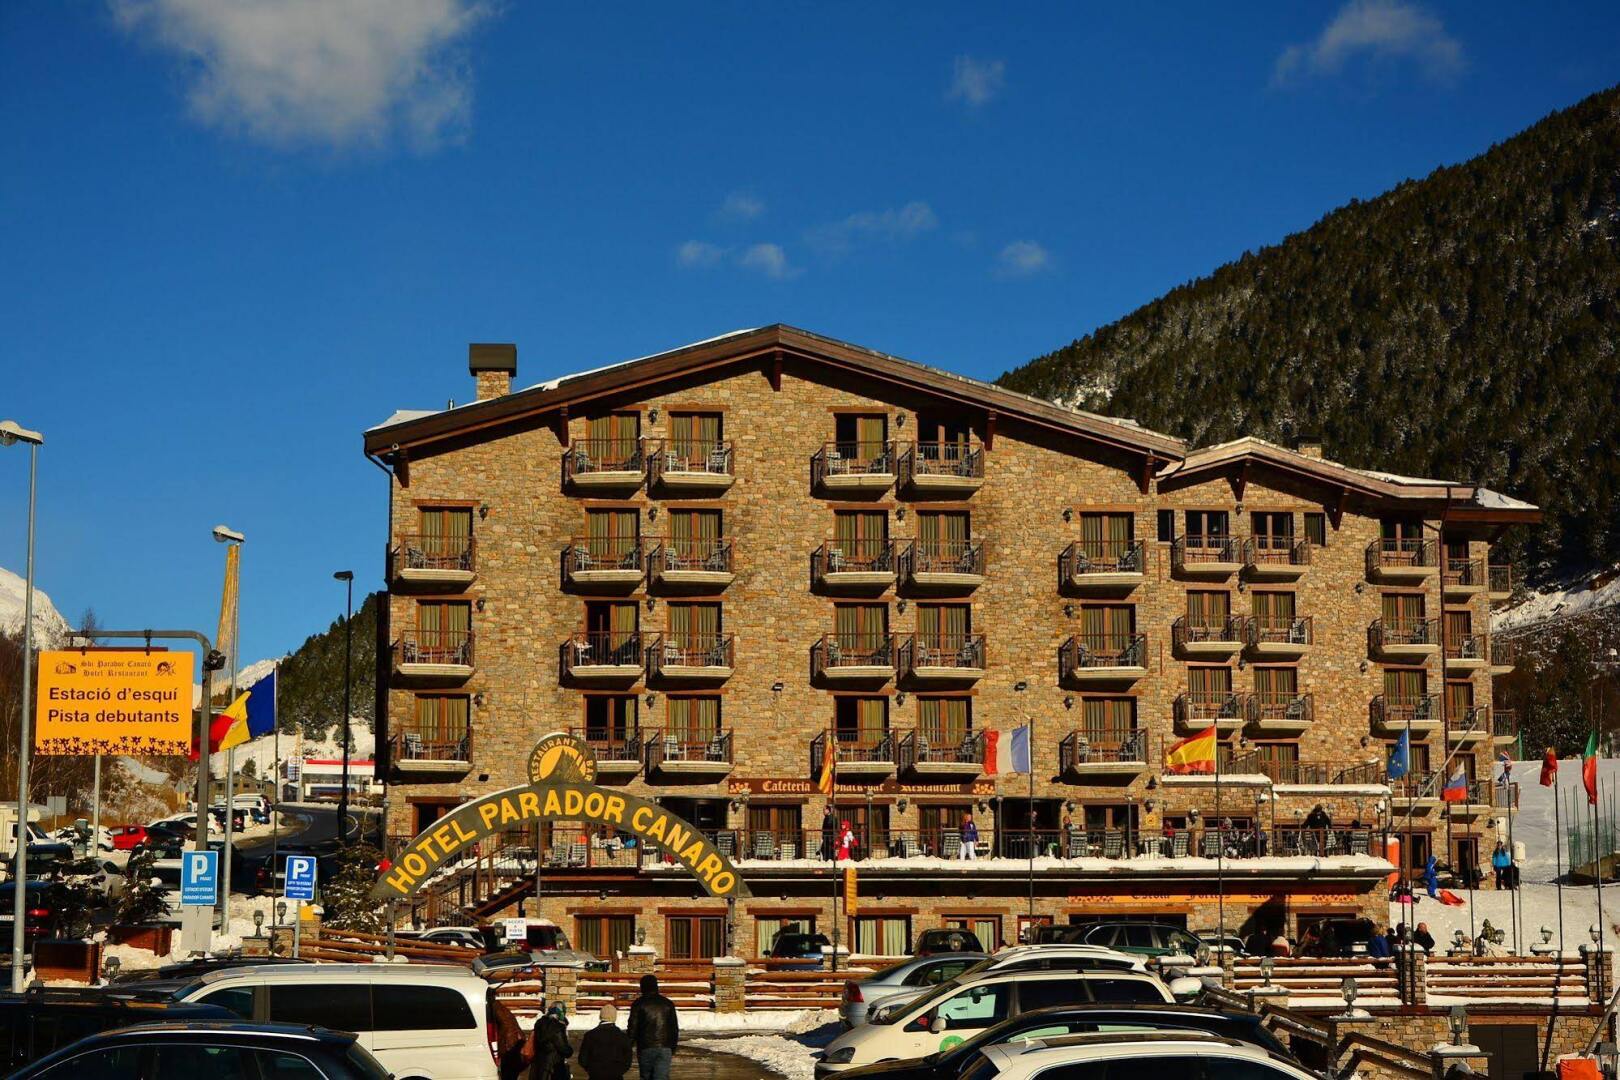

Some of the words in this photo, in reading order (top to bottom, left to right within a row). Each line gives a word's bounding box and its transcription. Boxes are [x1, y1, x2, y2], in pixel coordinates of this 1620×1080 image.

[108, 669, 148, 677] Restaurant
[49, 687, 111, 701] Estació
[116, 687, 178, 703] d'esquí
[48, 709, 90, 723] Pista
[95, 709, 180, 723] debutants
[531, 737, 578, 782] RESTAURANT
[584, 759, 594, 782] BAR
[762, 780, 811, 792] Cafeteria
[386, 819, 477, 895] HOTEL
[477, 788, 627, 832] PARADOR
[631, 806, 736, 896] CANARO
[191, 854, 208, 884] P
[292, 859, 309, 880] P
